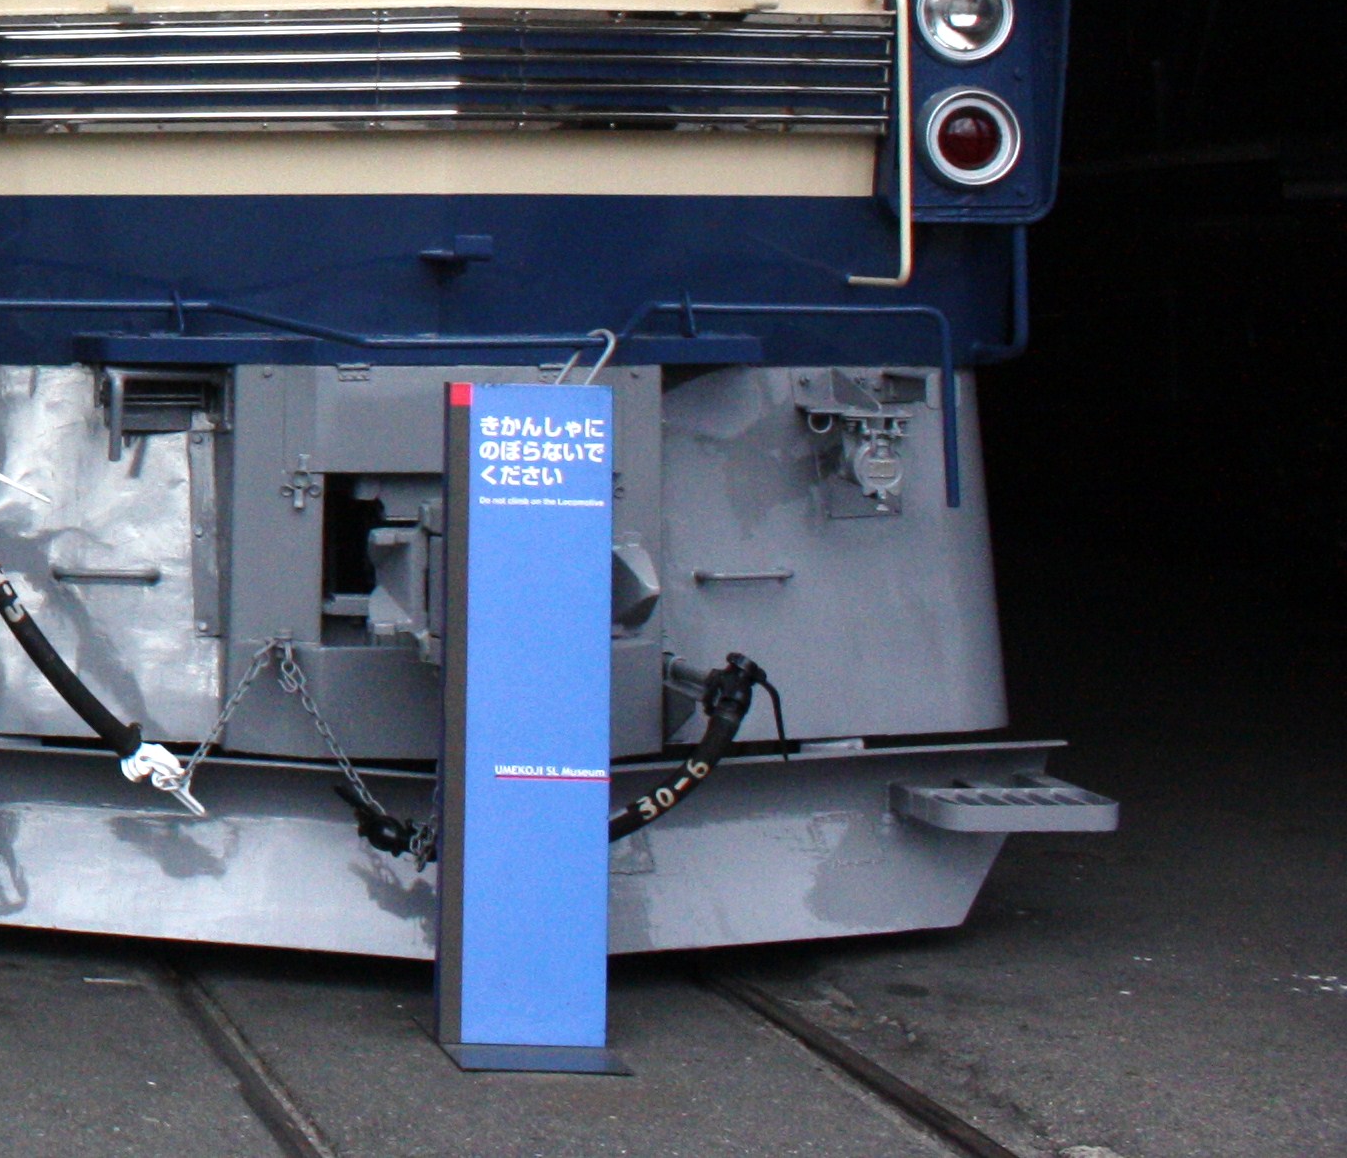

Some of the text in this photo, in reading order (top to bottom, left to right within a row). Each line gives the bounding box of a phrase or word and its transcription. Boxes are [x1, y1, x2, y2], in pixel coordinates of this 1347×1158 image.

[480, 415, 605, 438] きかんしゃに
[479, 440, 605, 463] のぼらないで
[480, 465, 563, 486] ください
[479, 496, 490, 504] Do
[492, 497, 506, 505] not
[507, 497, 529, 505] climb
[542, 497, 556, 506] the
[557, 498, 605, 507] Locomotive
[494, 765, 606, 777] UMEKOJI SL Museum
[635, 758, 710, 821] 30-6
